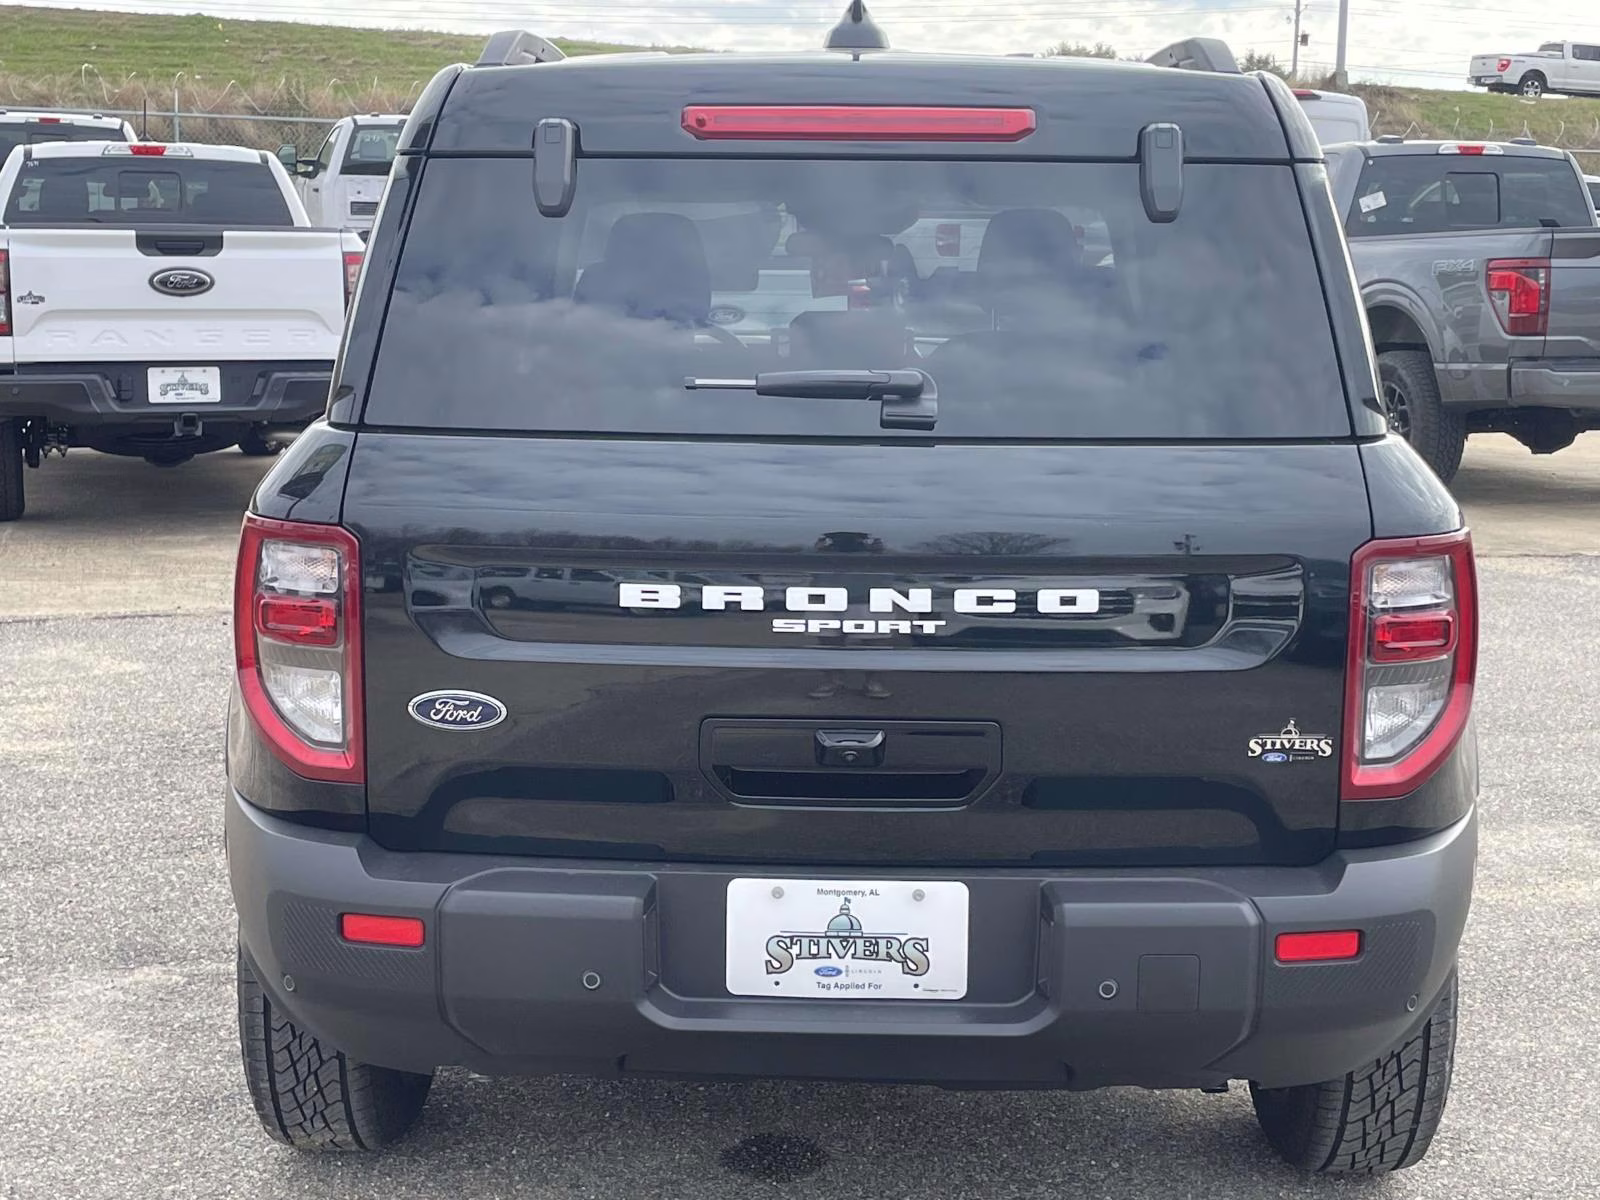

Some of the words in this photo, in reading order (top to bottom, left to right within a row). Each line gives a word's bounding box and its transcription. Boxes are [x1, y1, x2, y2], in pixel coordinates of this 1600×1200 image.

[167, 274, 198, 288] Ford
[46, 328, 318, 347] RANGER
[619, 583, 1100, 614] BRONCO
[772, 618, 947, 635] SPORT
[430, 698, 483, 722] Ford
[1247, 738, 1333, 757] STIVERS
[816, 887, 867, 898] Montgomery,
[869, 888, 880, 896] AL
[765, 935, 930, 977] STIVERS
[816, 982, 831, 990] Tag
[833, 982, 866, 990] Applied
